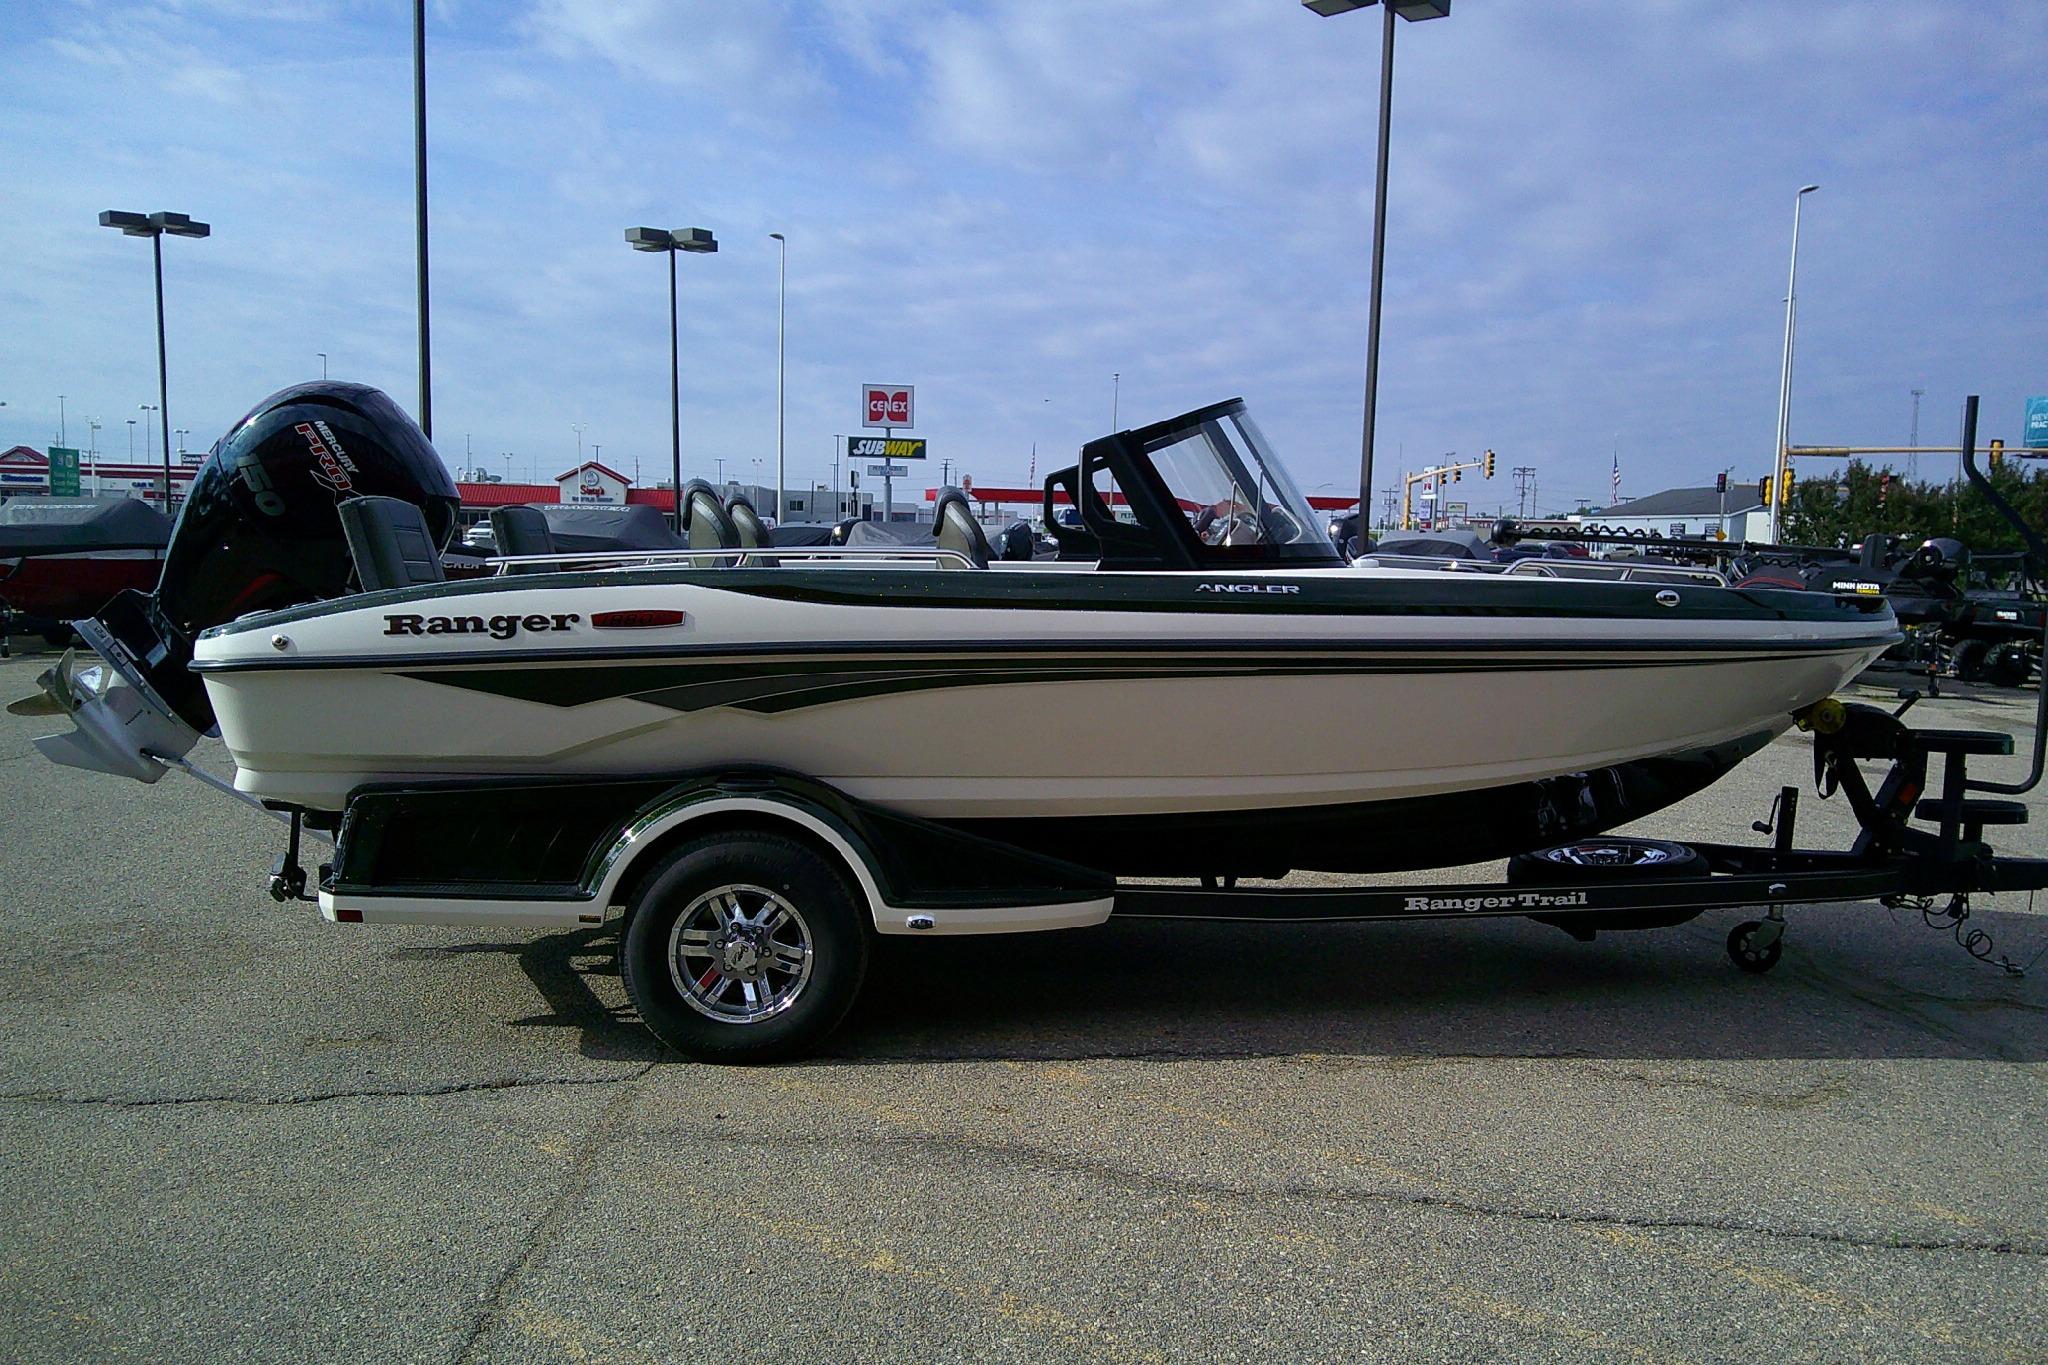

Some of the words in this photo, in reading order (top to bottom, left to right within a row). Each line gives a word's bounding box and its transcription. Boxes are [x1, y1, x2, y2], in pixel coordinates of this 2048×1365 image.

[870, 400, 907, 413] CENEX
[314, 420, 360, 473] MERCURY
[852, 439, 924, 456] SUBWAY
[295, 423, 352, 491] PRO
[236, 453, 286, 517] 150
[1194, 583, 1300, 594] ANGLER
[1832, 581, 1856, 590] MINN
[1856, 582, 1880, 590] KOTA
[383, 613, 580, 640] Ranger
[1404, 894, 1515, 912] Ranger
[1518, 892, 1588, 907] Trail
